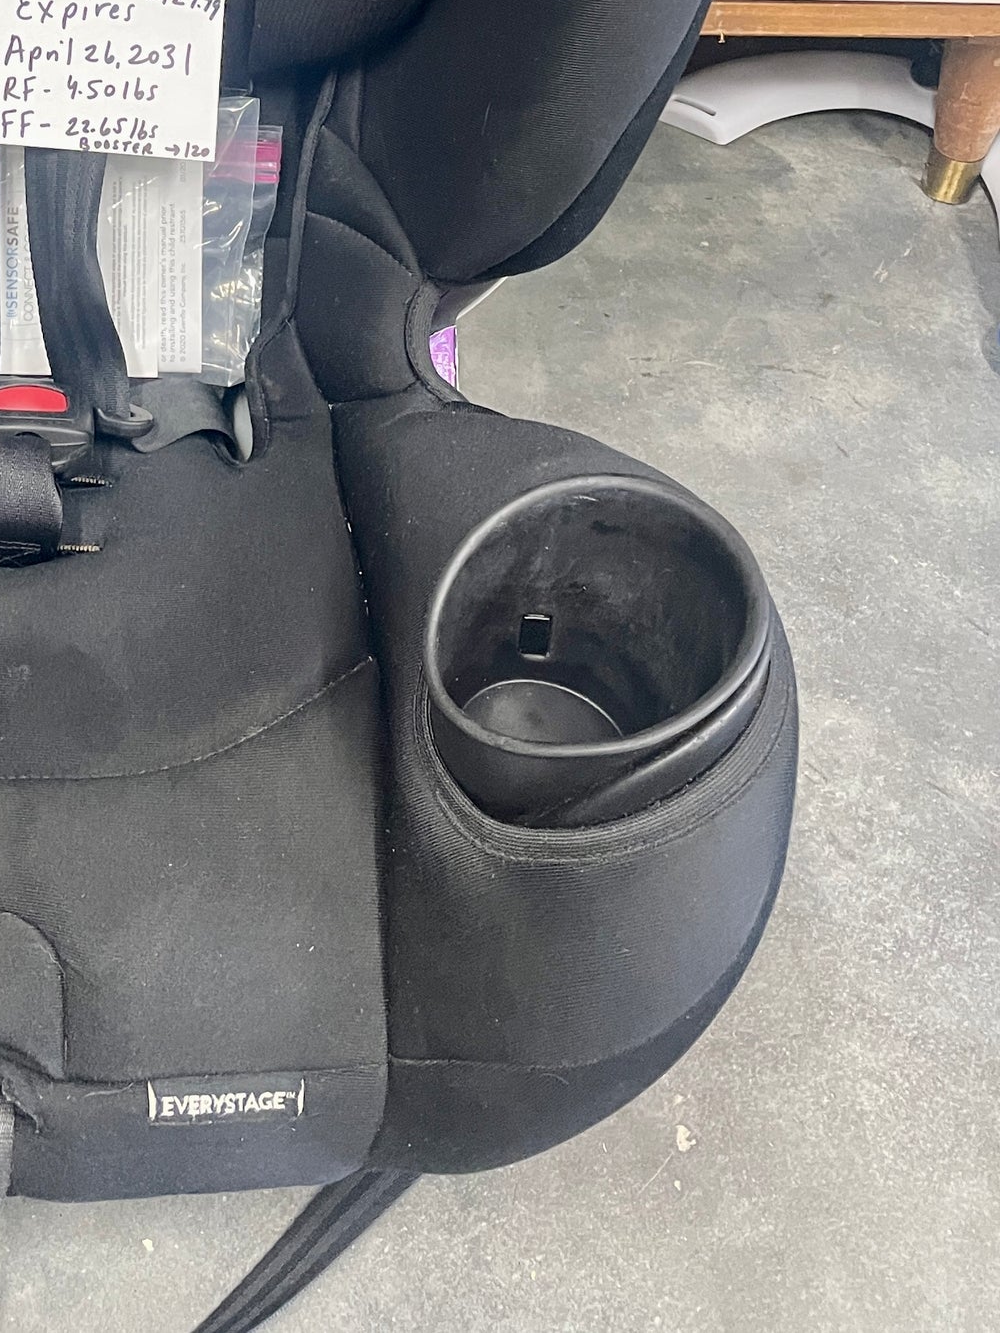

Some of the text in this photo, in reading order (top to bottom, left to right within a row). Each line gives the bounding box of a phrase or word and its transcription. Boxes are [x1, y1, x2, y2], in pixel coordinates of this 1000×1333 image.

[4, 34, 73, 72] April
[128, 43, 191, 76] 2031
[79, 137, 210, 157] BOOSTER 120
